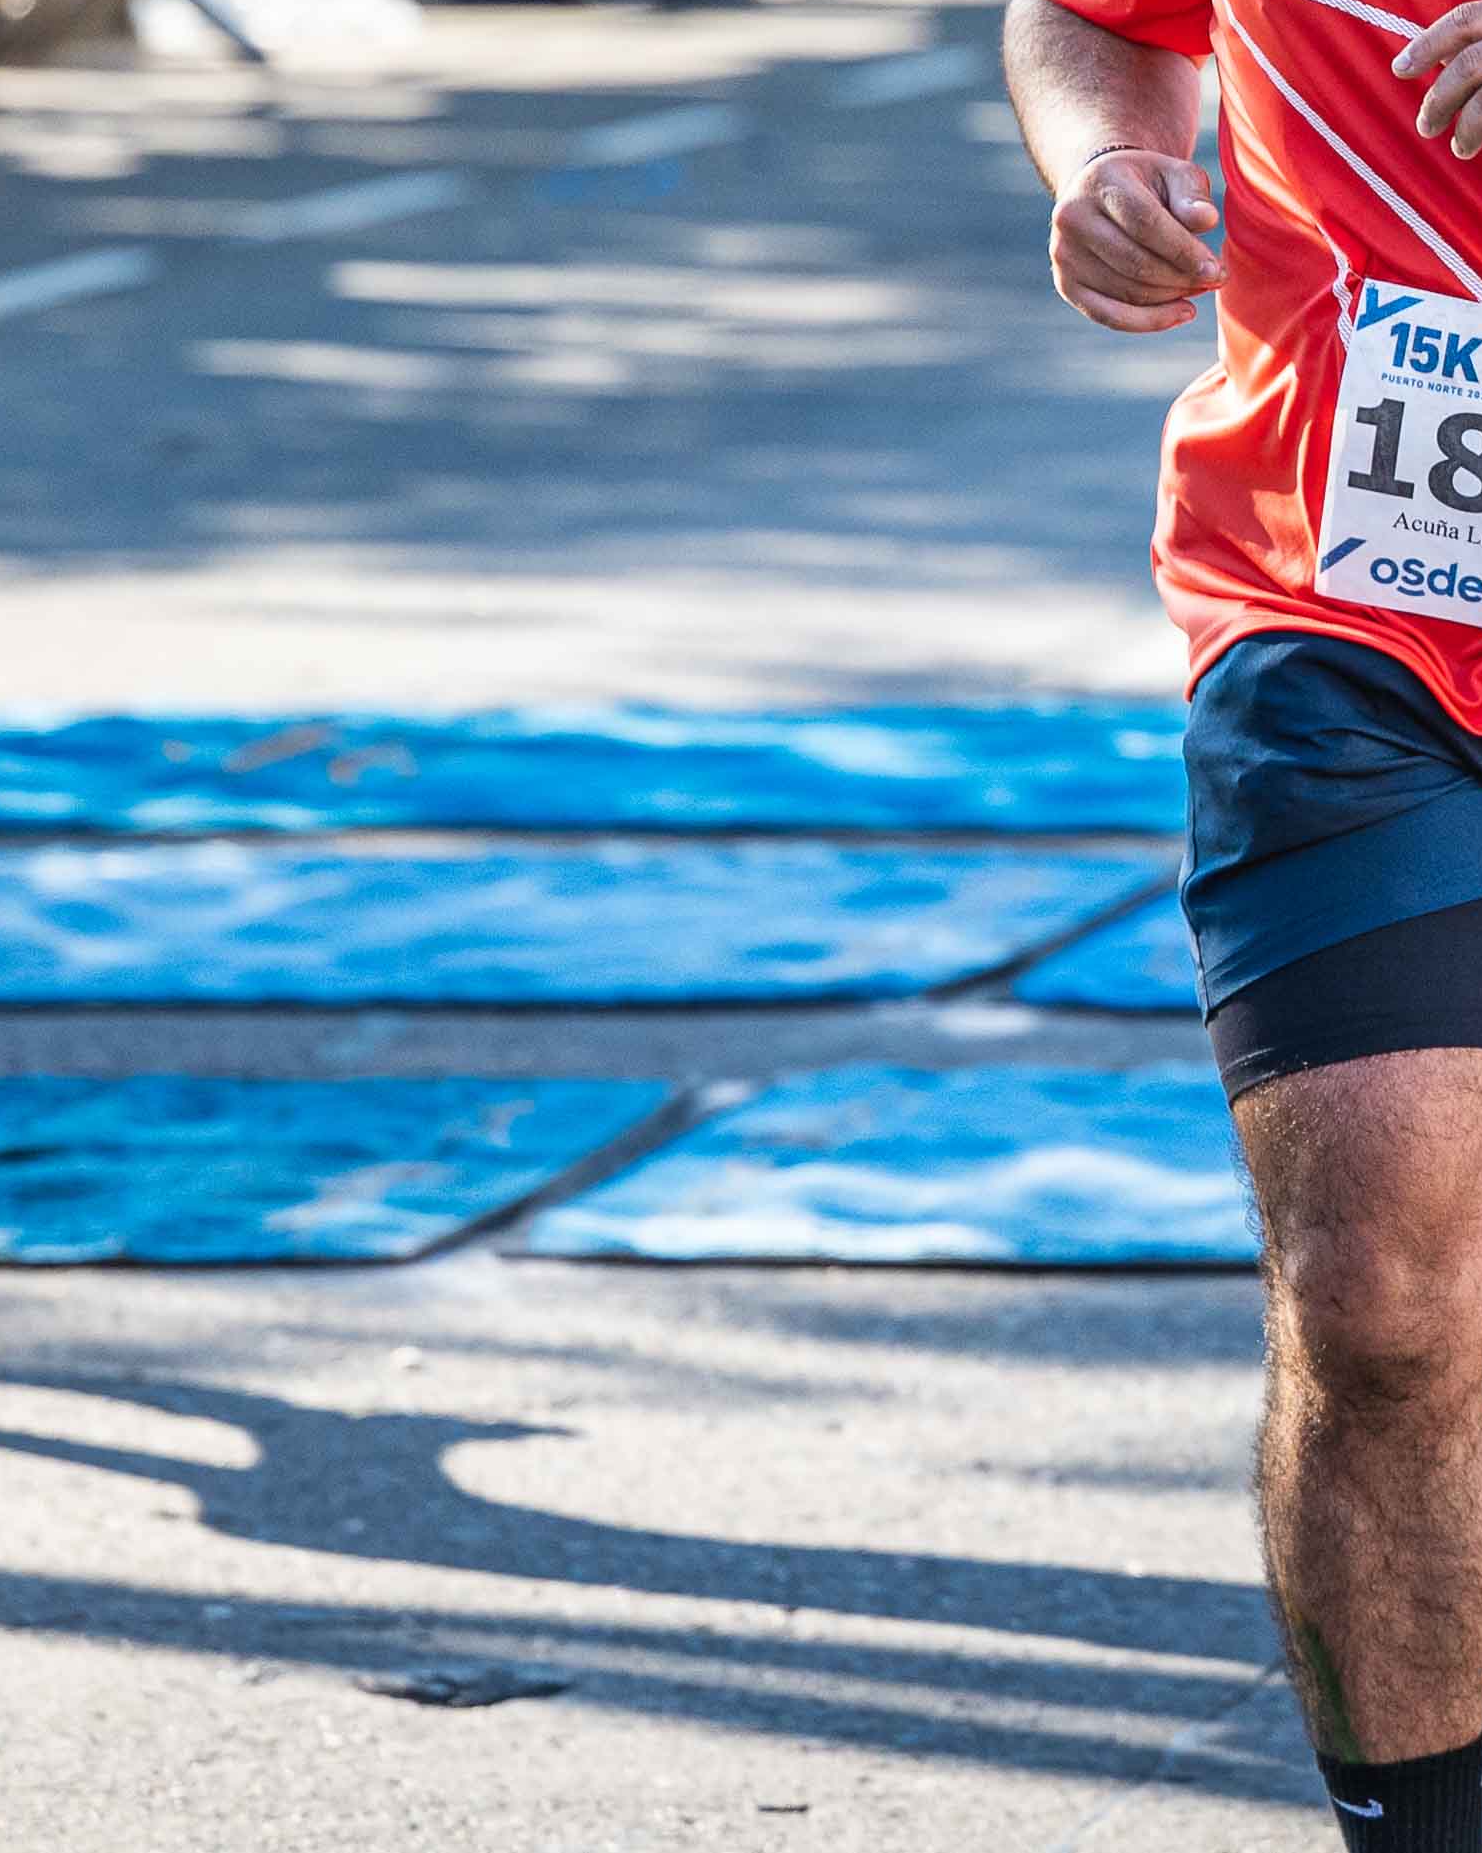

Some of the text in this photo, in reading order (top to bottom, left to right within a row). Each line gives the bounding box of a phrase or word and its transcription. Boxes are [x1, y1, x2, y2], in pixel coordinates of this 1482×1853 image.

[1381, 372, 1424, 389] PUERTO
[1428, 382, 1463, 397] NORTE
[1392, 511, 1459, 541] Acuña
